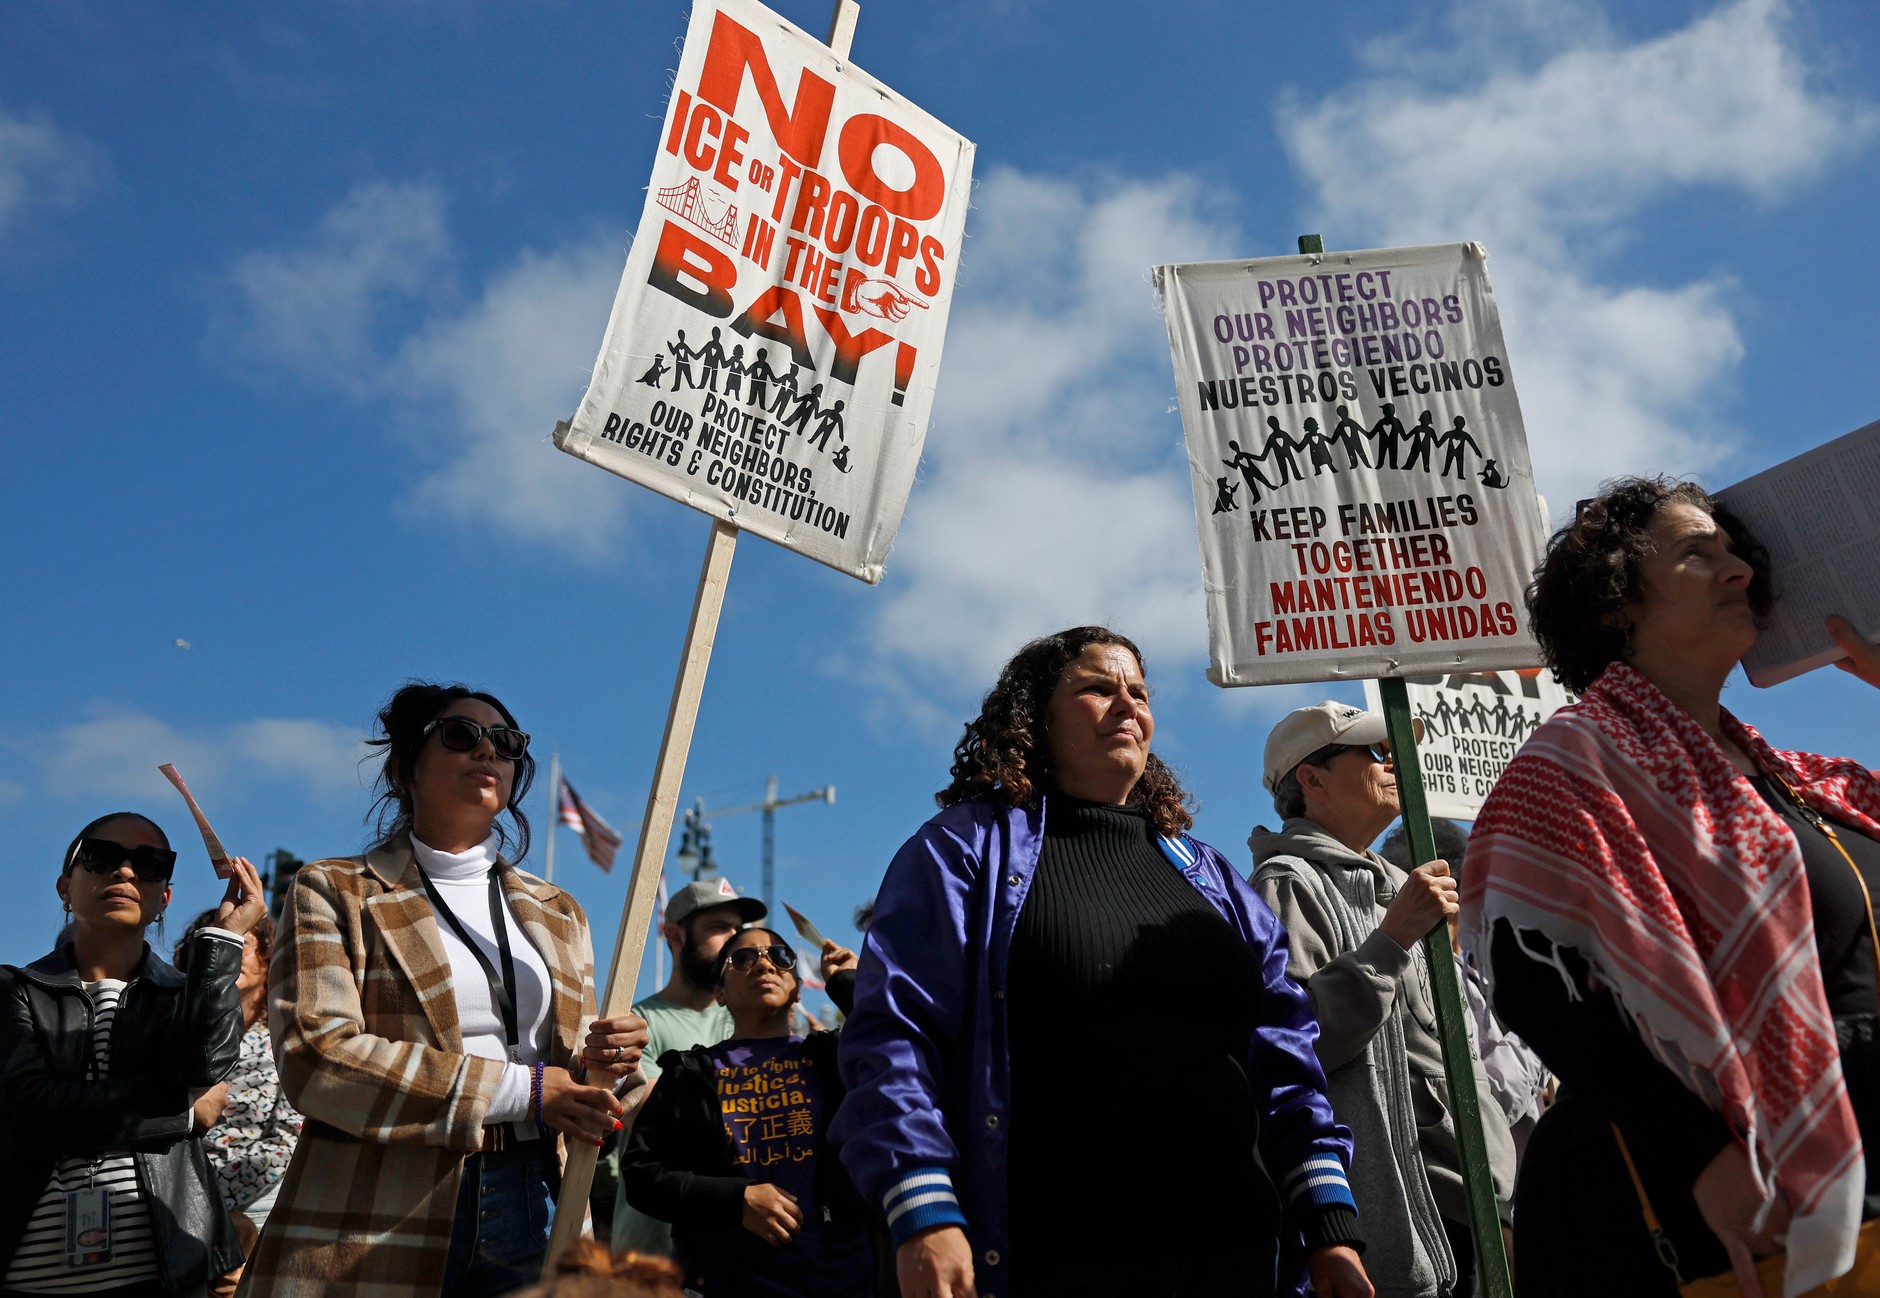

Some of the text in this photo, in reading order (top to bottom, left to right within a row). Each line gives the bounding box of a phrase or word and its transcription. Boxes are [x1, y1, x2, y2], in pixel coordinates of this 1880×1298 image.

[698, 9, 945, 220] NO
[666, 90, 944, 297] ICE OR TROOPS
[741, 212, 842, 305] IN THE
[647, 219, 917, 407] BAY!
[1258, 271, 1391, 308] PROTECT
[1214, 295, 1464, 343] OUR NEIGHBORS
[1233, 330, 1444, 374] PROTEGIENDO
[1198, 356, 1505, 410] NUESTROS VECINOS
[700, 392, 790, 454] PROTECT
[650, 400, 816, 498] OUR NEIGHBORS,
[601, 412, 850, 540] RIGHTS & CONSTITUTION
[1250, 494, 1478, 542] KEEP FAMILIES
[1292, 534, 1452, 575] TOGETHER
[1270, 566, 1486, 615] MANTENIENDO
[1254, 602, 1517, 656] FAMILIAS UNIDAS
[1424, 753, 1453, 773] OUR
[1452, 736, 1516, 759] PROTECT
[1461, 777, 1470, 795] &
[1475, 779, 1494, 796] CO
[742, 1067, 758, 1076] to
[721, 1089, 812, 1113] usticia.
